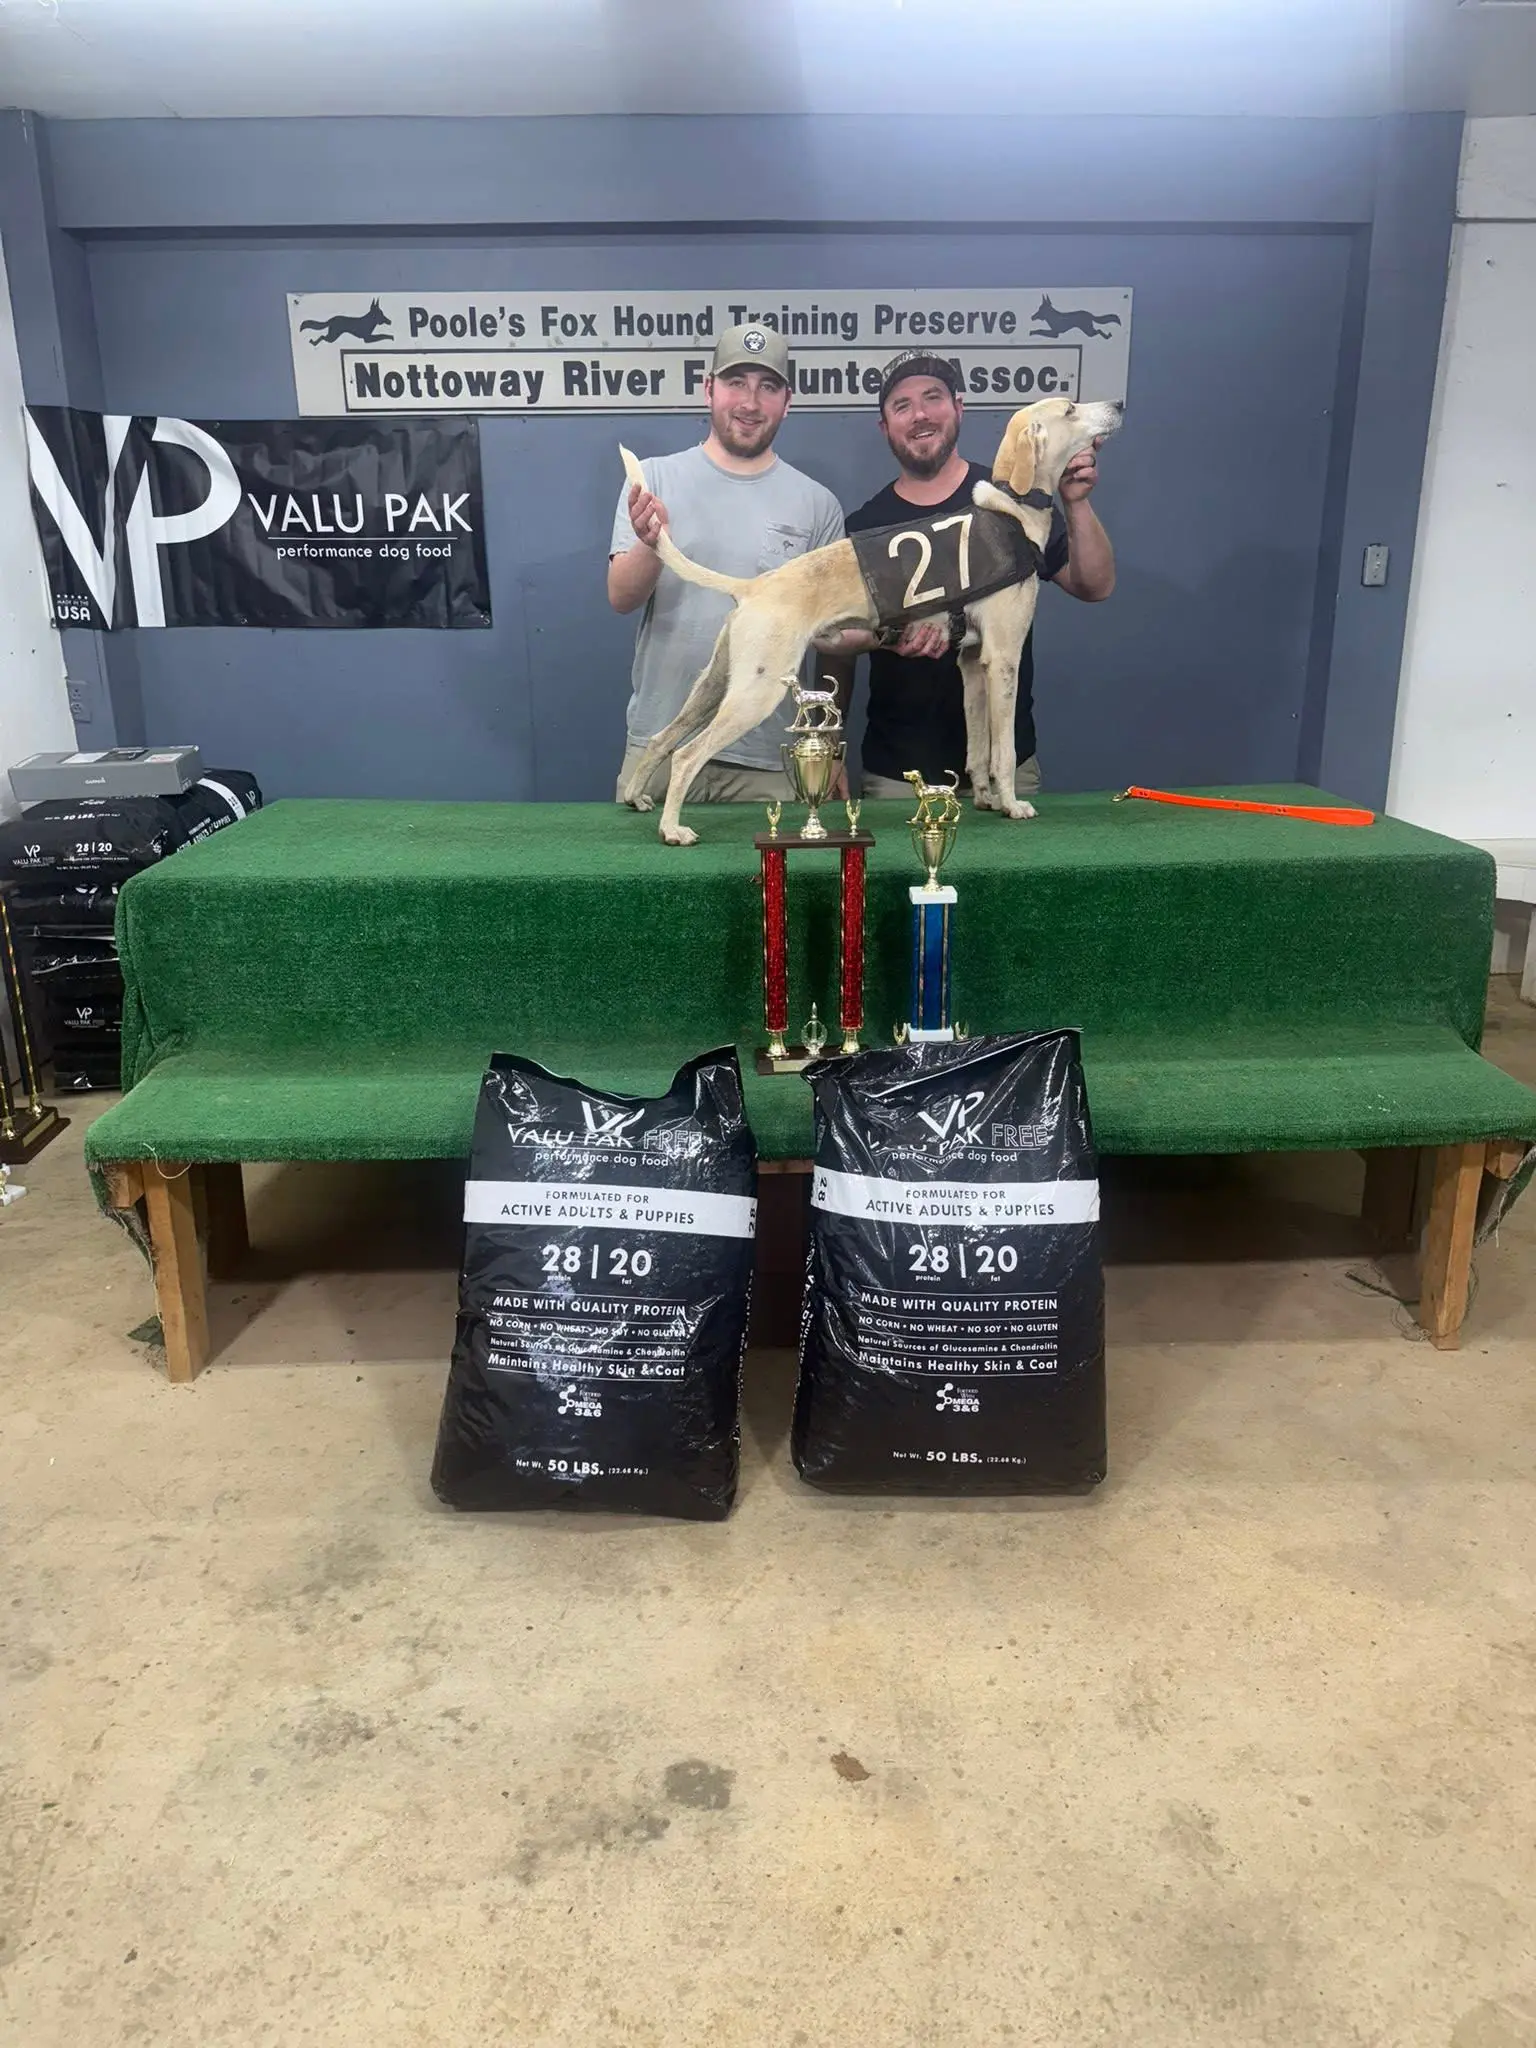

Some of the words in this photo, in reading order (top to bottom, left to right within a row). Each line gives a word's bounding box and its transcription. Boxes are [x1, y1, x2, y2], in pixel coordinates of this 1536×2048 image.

[409, 305, 525, 338] Poole's
[541, 305, 599, 337] Fox
[614, 304, 713, 337] Hound
[875, 304, 1017, 337] Preserve
[353, 362, 544, 405] Nottoway
[563, 359, 665, 397] River
[24, 406, 242, 630] VP
[247, 493, 364, 534] VALU
[386, 492, 473, 533] PAK
[276, 545, 373, 560] performance
[379, 544, 410, 561] dog
[416, 543, 452, 558] food
[888, 512, 974, 609] 27
[57, 605, 91, 621] USA
[24, 844, 41, 857] VP
[75, 843, 89, 853] 28
[98, 842, 113, 852] 20
[76, 1007, 93, 1020] VP
[918, 1091, 985, 1139] VP
[508, 1123, 574, 1146] VALU
[643, 1130, 702, 1152] FREE
[939, 1123, 983, 1155] PAK
[992, 1123, 1048, 1147] FREE
[535, 1151, 609, 1165] performance
[614, 1152, 636, 1167] dog
[641, 1156, 669, 1167] food
[892, 1150, 964, 1165] performance
[968, 1150, 987, 1163] dog
[991, 1150, 1017, 1162] food
[546, 1190, 621, 1203] FORMULATED
[627, 1193, 649, 1204] FOR
[906, 1189, 977, 1200] FORMULATED
[983, 1189, 1006, 1199] FOR
[500, 1204, 552, 1217] ACTIVE
[558, 1206, 613, 1220] ADULTS
[619, 1209, 629, 1221] &
[635, 1210, 695, 1225] PUPPIES
[865, 1199, 912, 1215] ACTIVE
[918, 1204, 971, 1217] ADULTS
[978, 1205, 988, 1216] &
[995, 1203, 1054, 1217] PUPPIES
[541, 1244, 582, 1273] 28
[608, 1248, 652, 1277] 20
[908, 1244, 949, 1272] 28
[975, 1245, 1017, 1273] 20
[621, 1277, 632, 1286] fat
[915, 1274, 941, 1283] protein
[990, 1274, 1001, 1282] fat
[492, 1296, 529, 1310] MADE
[533, 1298, 565, 1312] WITH
[571, 1301, 629, 1316] QUALITY
[634, 1304, 686, 1317] PROTEIN
[861, 1292, 897, 1308] MADE
[902, 1298, 936, 1311] WITH
[941, 1300, 1000, 1312] QUALITY
[1005, 1298, 1058, 1311] PROTEIN
[489, 1318, 503, 1328] NO
[506, 1320, 531, 1331] CORN
[540, 1322, 553, 1331] NO
[595, 1326, 608, 1335] NO
[638, 1329, 650, 1337] NO
[858, 1316, 873, 1325] NO
[875, 1318, 900, 1329] CORN
[910, 1323, 924, 1332] NO
[927, 1324, 958, 1334] WHEAT
[967, 1325, 982, 1334] NO
[984, 1324, 1002, 1333] SOY
[1010, 1323, 1024, 1332] NO
[1026, 1322, 1058, 1332] GLUTEN
[490, 1337, 518, 1347] Natural
[858, 1335, 890, 1347] Natural
[893, 1340, 926, 1351] Sources
[929, 1342, 939, 1352] of
[942, 1343, 999, 1352] Glucosamine
[1001, 1343, 1007, 1352] &
[1010, 1341, 1058, 1351] Chondroitin
[488, 1353, 547, 1370] Maintains
[552, 1360, 602, 1377] Healthy
[608, 1364, 635, 1377] Skin
[641, 1366, 648, 1375] &
[655, 1366, 685, 1376] Coat
[859, 1351, 922, 1371] Maintains
[928, 1359, 979, 1374] Healthy
[984, 1360, 1011, 1372] Skin
[1016, 1360, 1025, 1371] &
[1030, 1359, 1058, 1371] Coat
[893, 1451, 907, 1459] Net
[926, 1451, 946, 1462] 50
[952, 1452, 983, 1464] LBS.
[516, 1459, 529, 1468] Net
[548, 1459, 568, 1472] 50
[573, 1461, 604, 1475] LBS.
